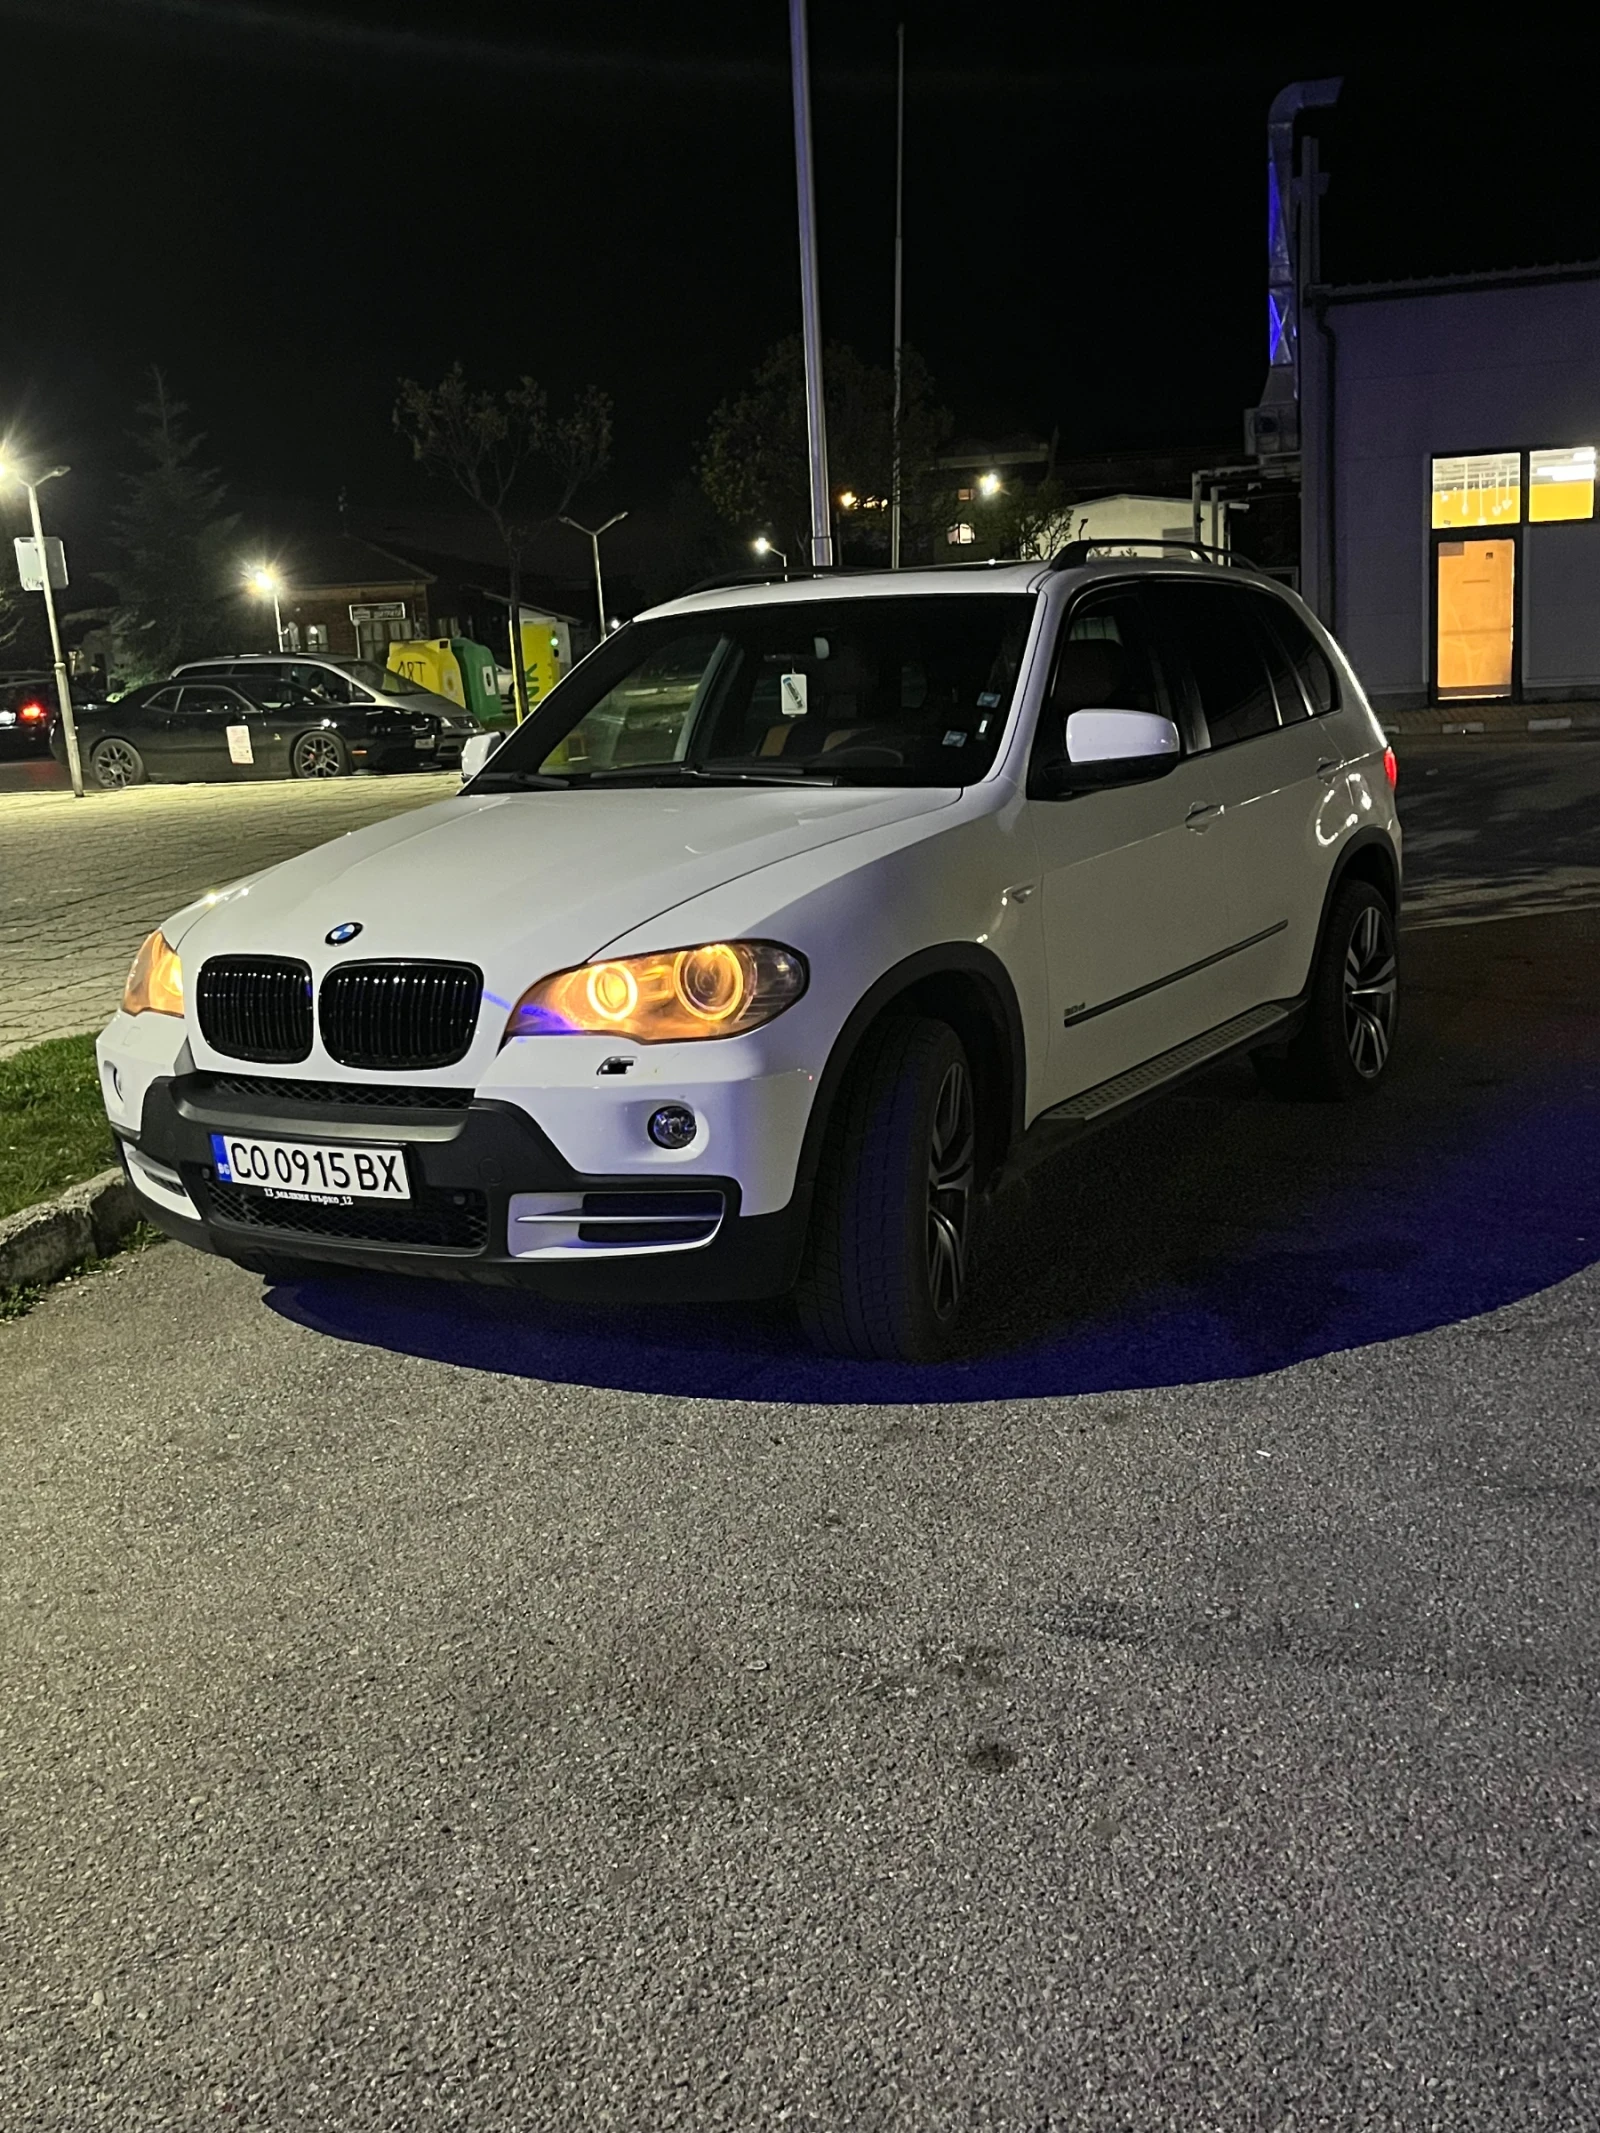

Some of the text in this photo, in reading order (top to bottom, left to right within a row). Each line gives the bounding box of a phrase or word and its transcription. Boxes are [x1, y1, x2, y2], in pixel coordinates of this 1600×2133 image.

[230, 1142, 403, 1193] CO 0915 BX
